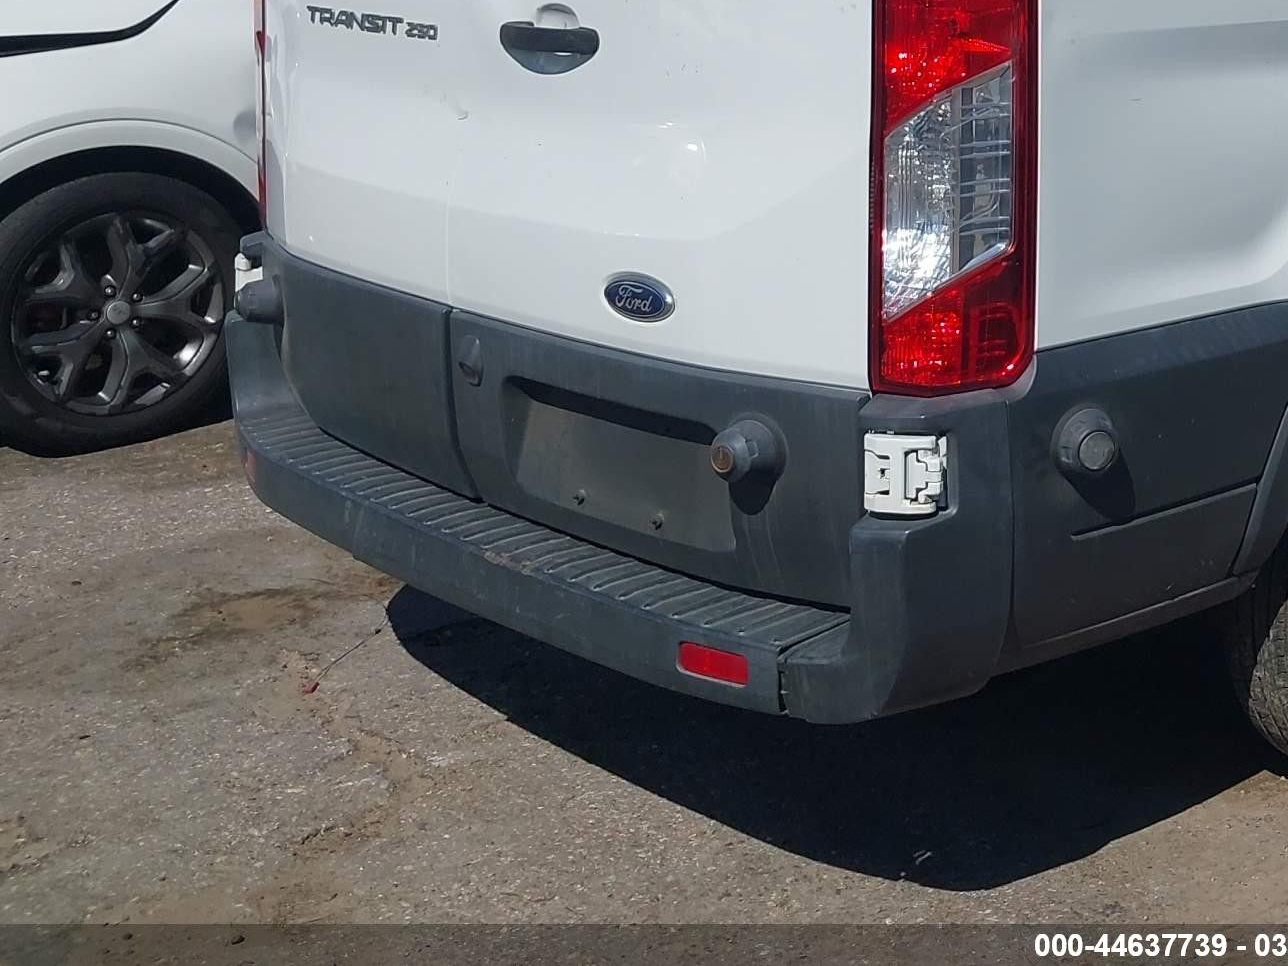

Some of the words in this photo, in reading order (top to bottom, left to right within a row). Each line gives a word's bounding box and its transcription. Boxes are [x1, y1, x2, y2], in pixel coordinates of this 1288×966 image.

[306, 5, 404, 36] TRANSIT
[405, 21, 439, 41] 250
[615, 284, 653, 312] Ford
